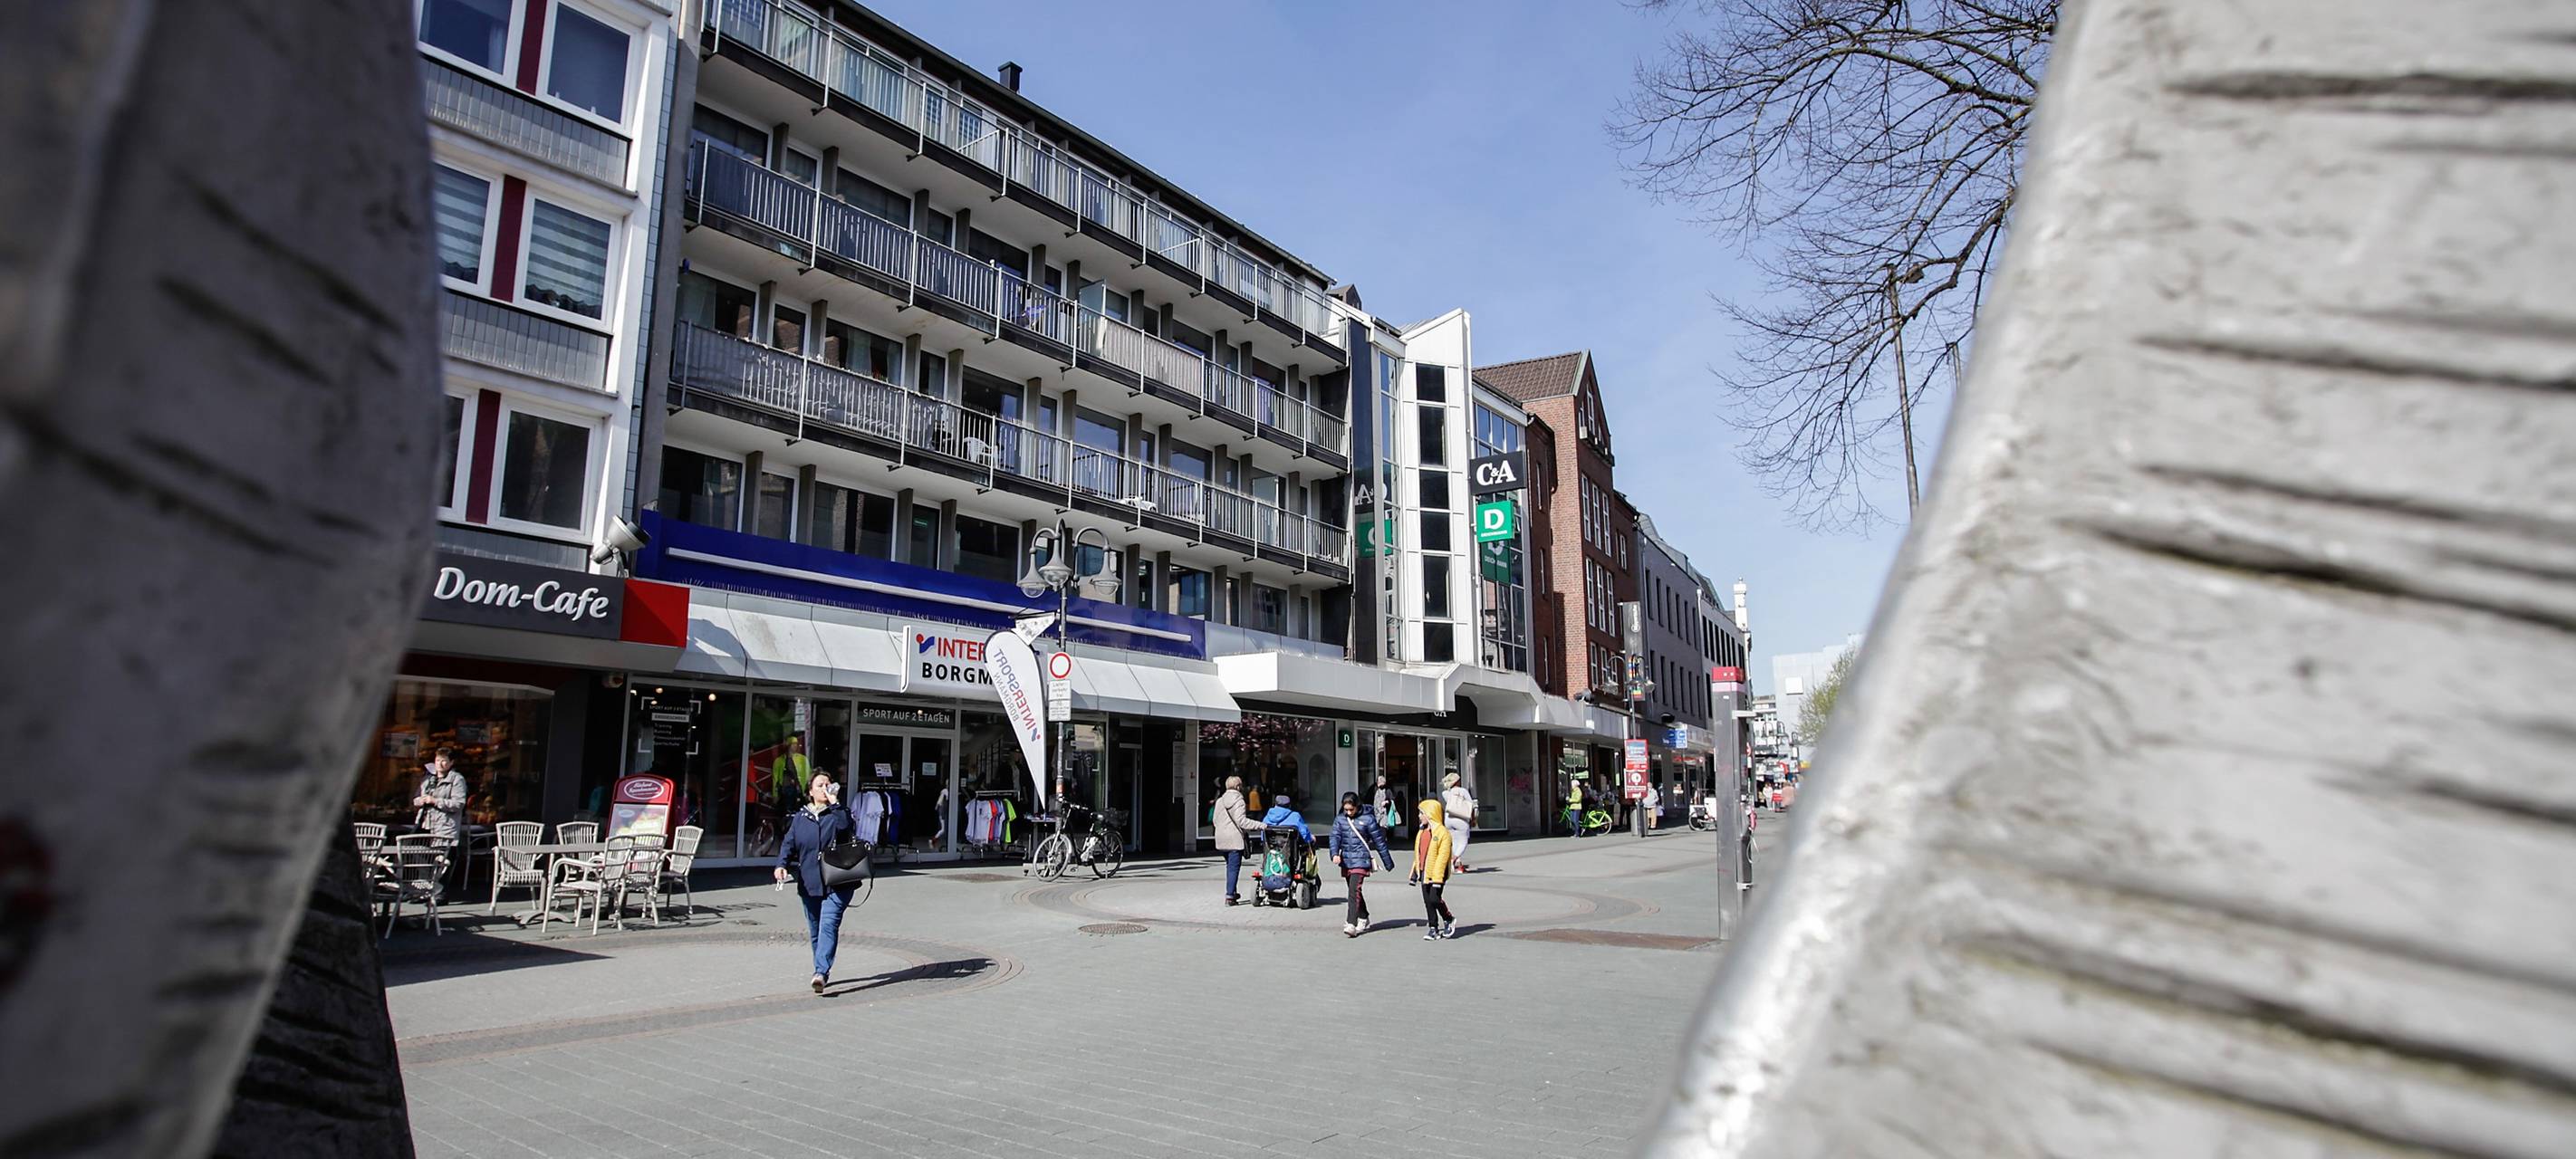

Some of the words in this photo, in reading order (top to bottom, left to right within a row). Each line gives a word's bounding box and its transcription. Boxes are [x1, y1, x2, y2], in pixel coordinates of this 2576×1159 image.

[1476, 460, 1516, 486] C&A
[1484, 509, 1504, 530] D
[433, 566, 610, 621] Dom-Cafe
[937, 637, 985, 661] INTER
[922, 662, 994, 685] BORGM
[862, 708, 892, 720] SPORT
[892, 711, 910, 721] AUF
[911, 713, 917, 722] 2
[918, 712, 950, 723] ETAGEN
